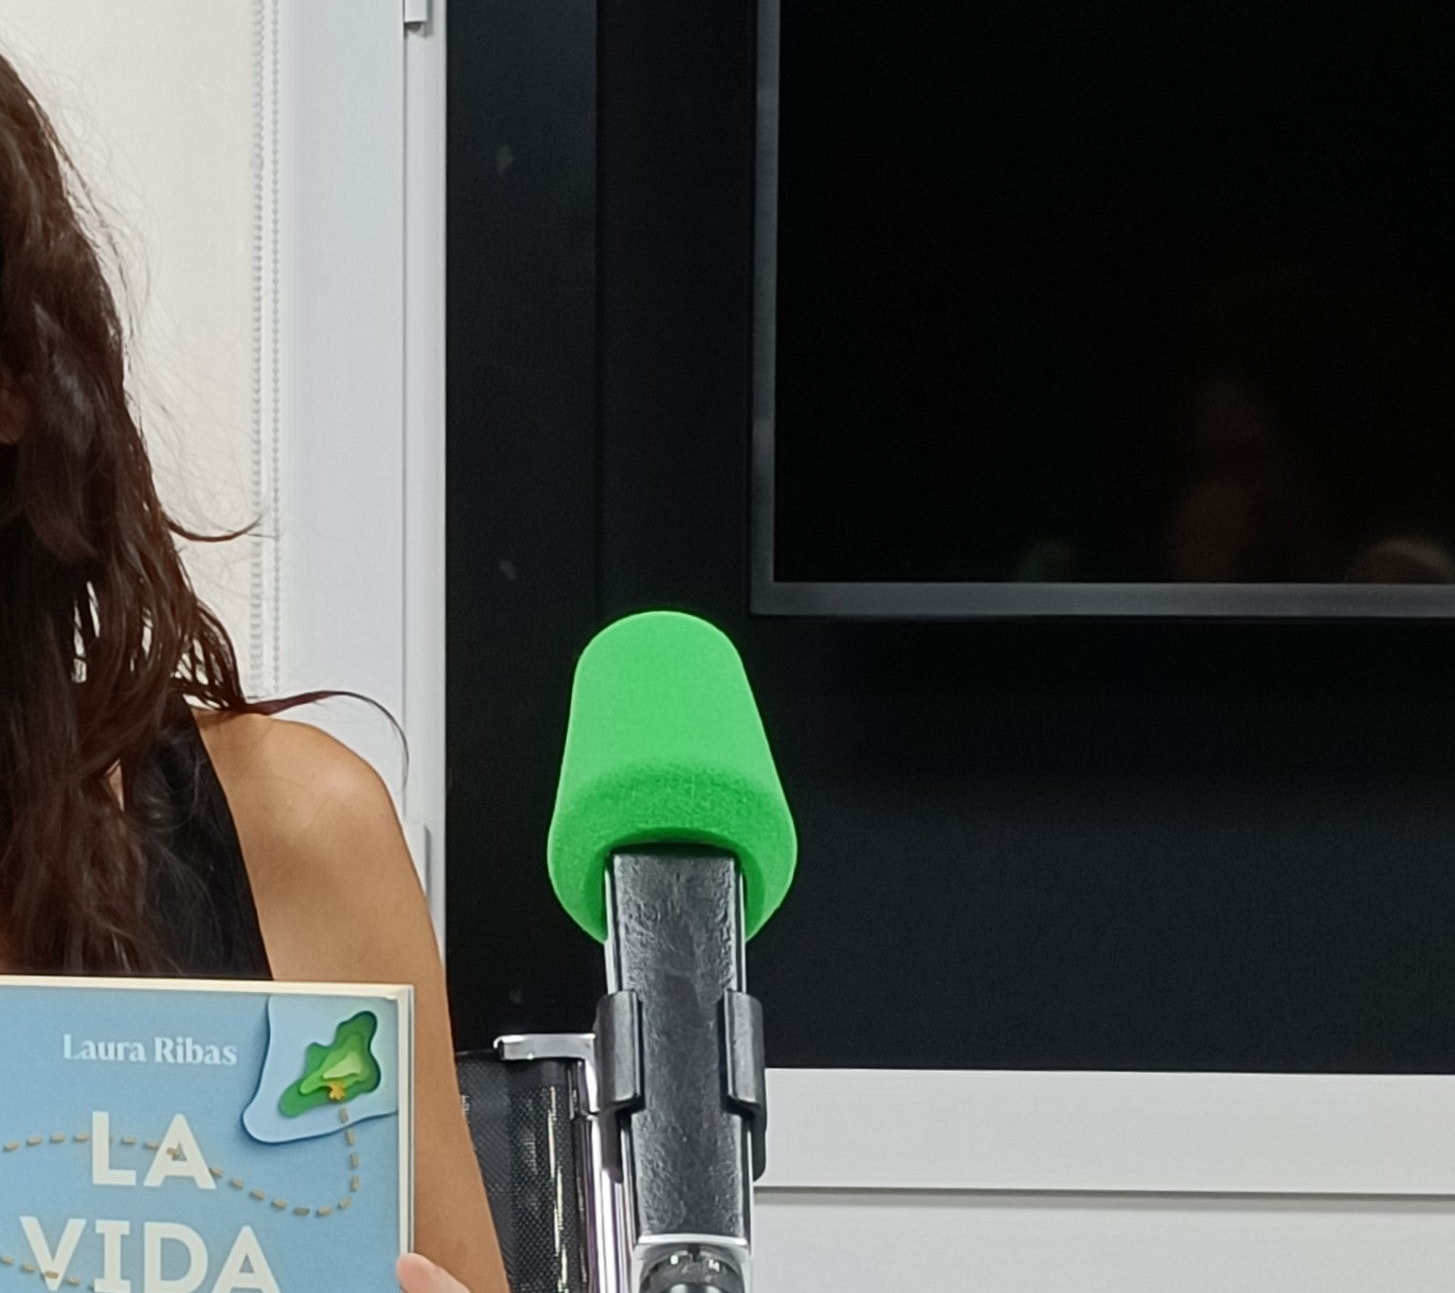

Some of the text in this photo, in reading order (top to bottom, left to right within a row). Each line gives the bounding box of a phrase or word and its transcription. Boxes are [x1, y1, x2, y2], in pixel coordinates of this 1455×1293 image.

[63, 1033, 238, 1066] Laura Ribas
[91, 1110, 217, 1190] LA
